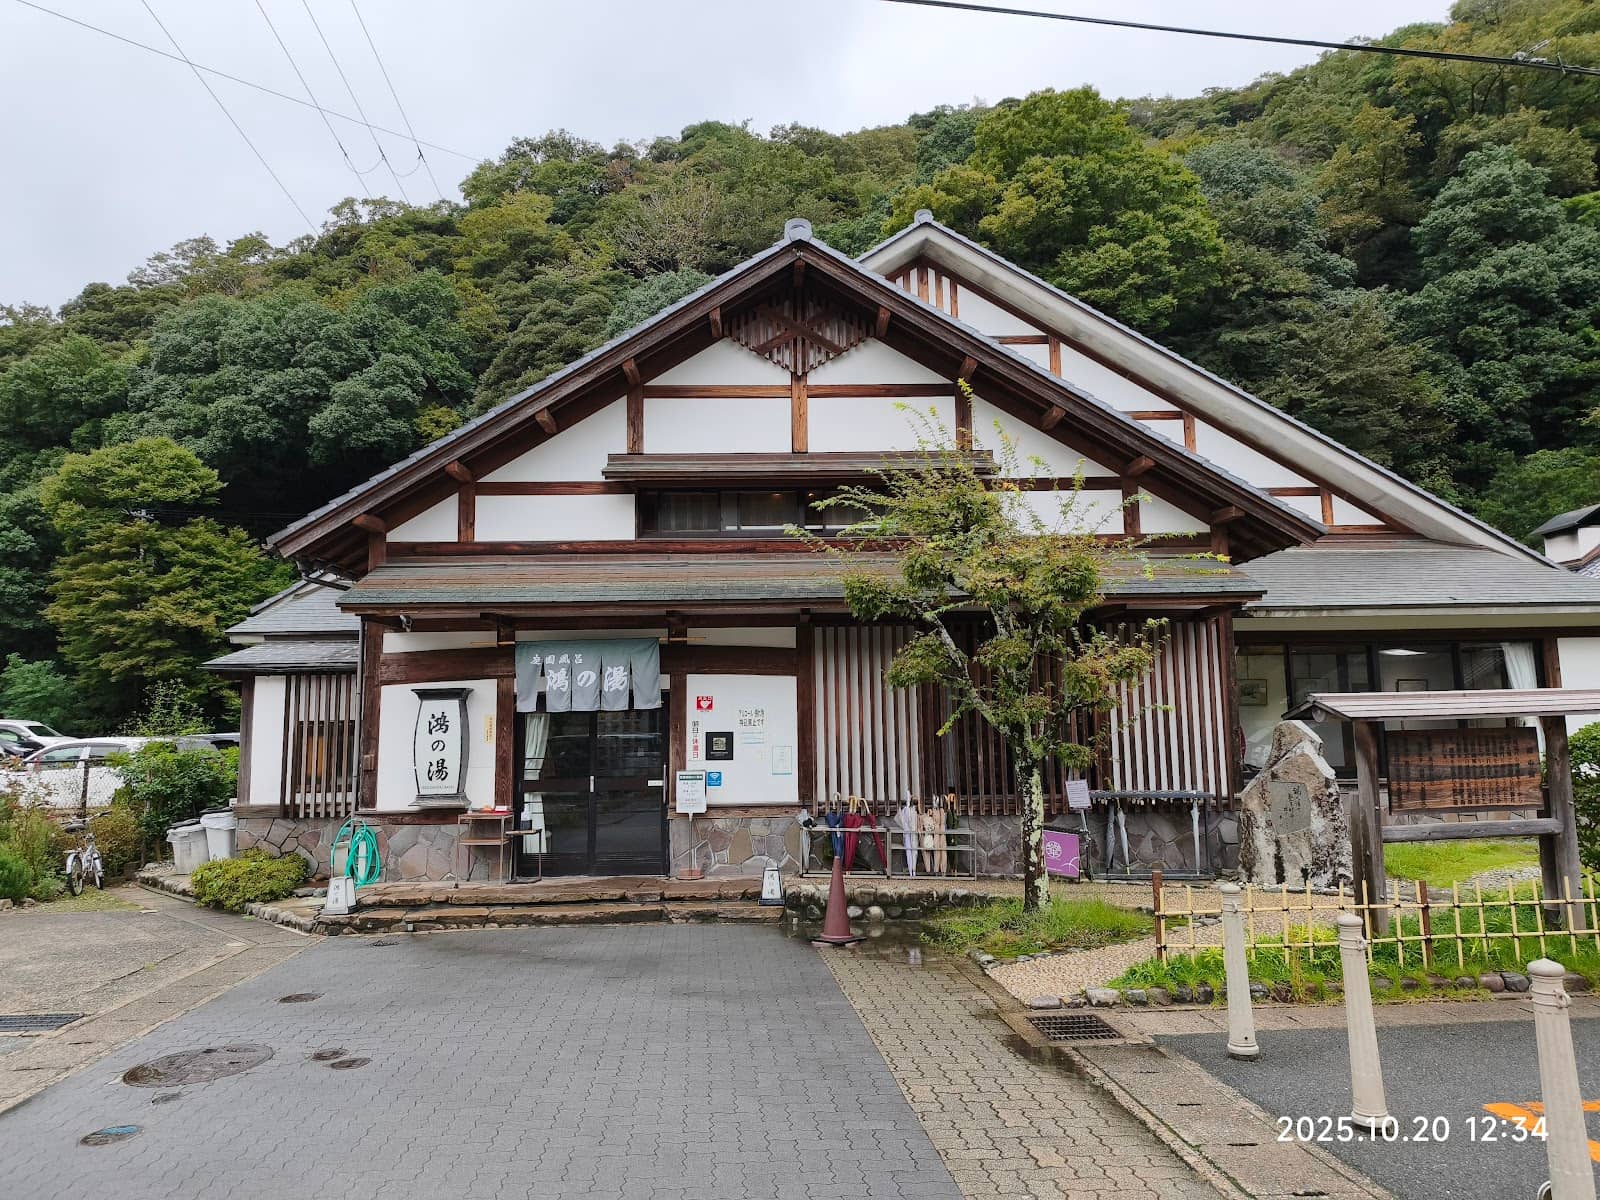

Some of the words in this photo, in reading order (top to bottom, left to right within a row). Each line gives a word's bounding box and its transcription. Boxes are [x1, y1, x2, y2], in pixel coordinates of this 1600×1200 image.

[546, 665, 628, 693] 鴻の湯
[427, 711, 450, 782] 鴻の湯
